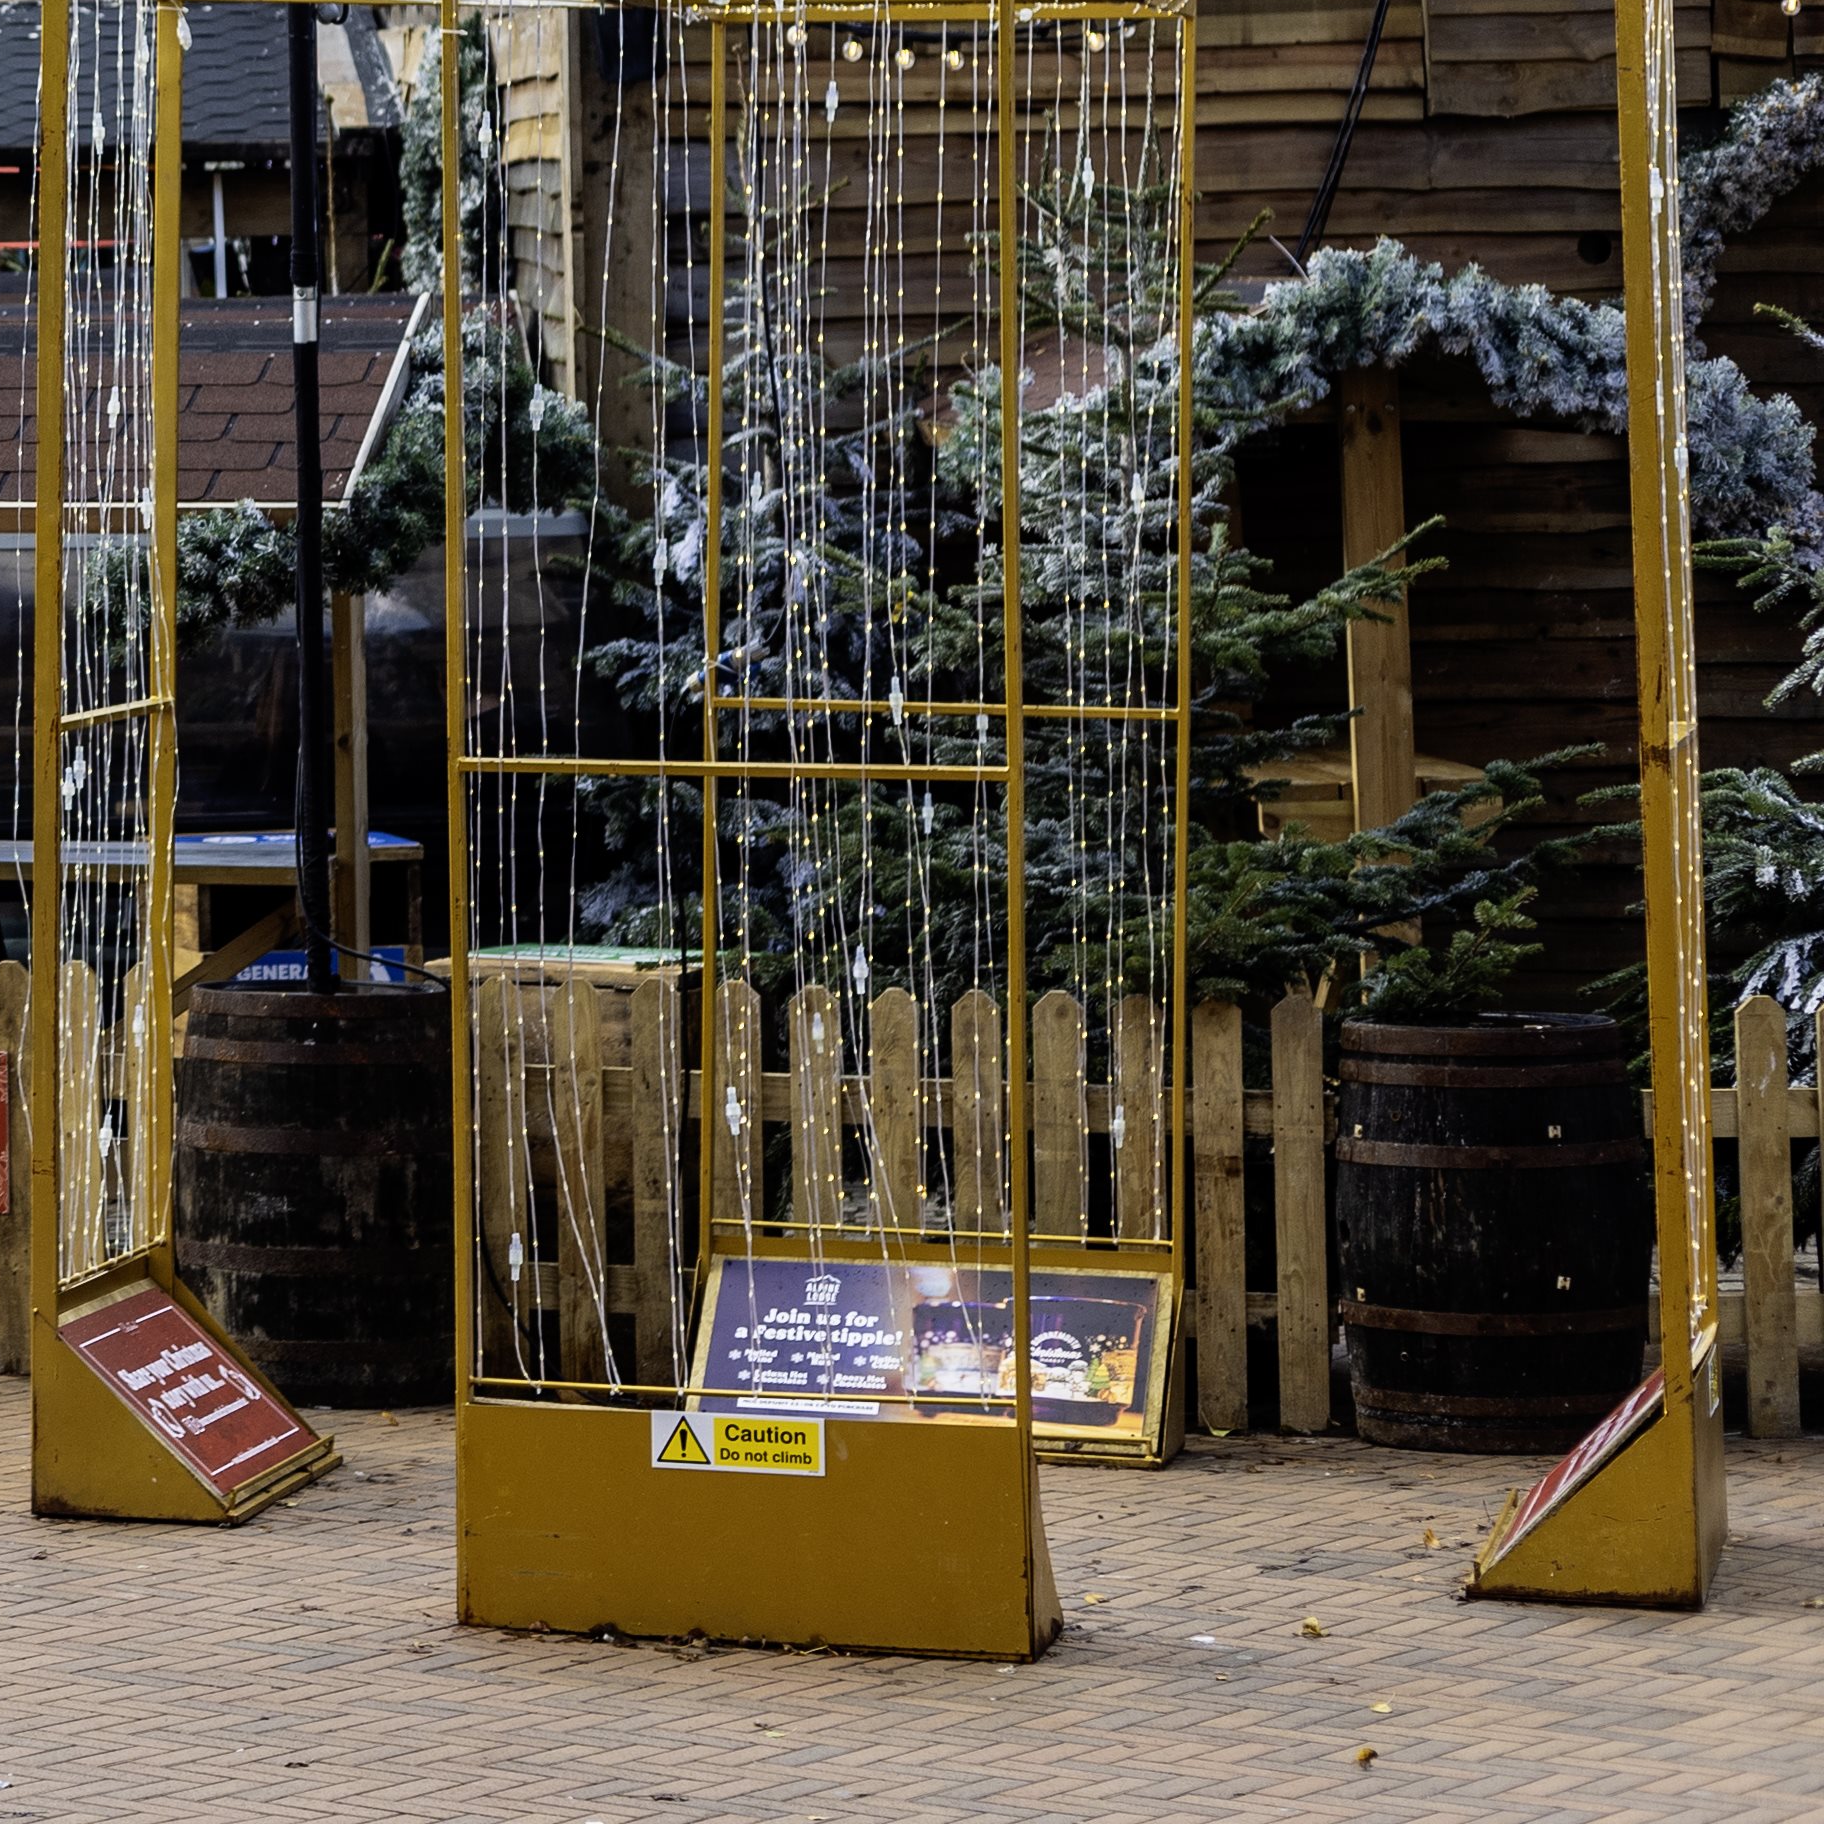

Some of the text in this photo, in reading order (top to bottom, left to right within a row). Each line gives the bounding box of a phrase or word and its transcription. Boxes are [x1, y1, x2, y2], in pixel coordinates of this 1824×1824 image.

[763, 1308, 880, 1328] Join us for
[734, 1324, 903, 1347] a Festive tipple!
[725, 1424, 806, 1445] Caution
[720, 1448, 812, 1465] Do not climb
